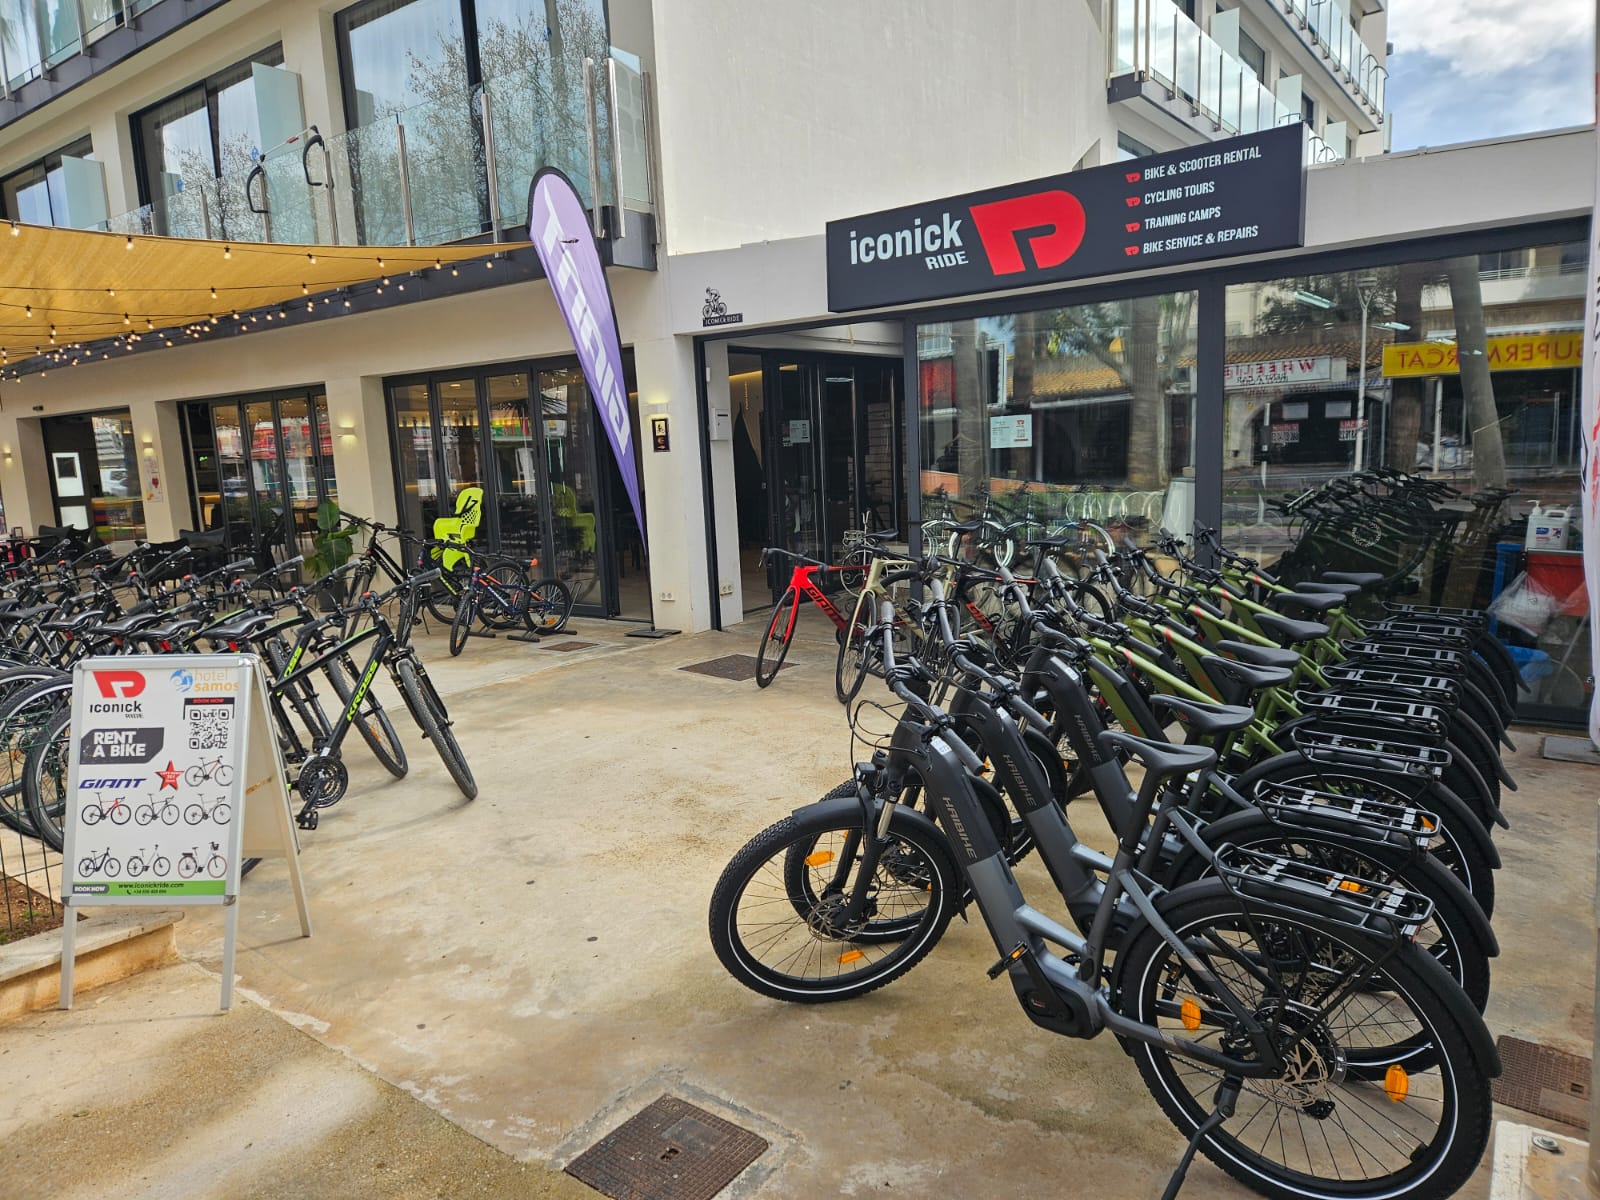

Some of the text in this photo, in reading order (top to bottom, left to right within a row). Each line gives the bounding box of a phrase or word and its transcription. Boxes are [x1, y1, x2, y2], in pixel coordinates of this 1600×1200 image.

[1144, 146, 1262, 181] BIKE & SCOOTER RENTAL
[1144, 181, 1216, 205] CYCLING TOURS
[1144, 206, 1222, 230] TRAINING CAMPS
[849, 212, 963, 265] iconick
[1143, 225, 1259, 255] BIKE SERVICE & REPAIRS
[924, 250, 969, 271] RIDE
[542, 179, 632, 457] GIANT
[705, 314, 741, 326] ICONICK RIDE
[194, 669, 229, 681] hotel
[194, 681, 240, 693] samos
[346, 659, 379, 722] KROSS
[93, 730, 137, 745] RENT
[1073, 713, 1102, 763] HAIBIKE
[92, 743, 147, 758] A BIKE
[78, 778, 148, 790] GIANT
[1002, 753, 1037, 807] HAIBIKE
[942, 796, 978, 860] HAIBIKE
